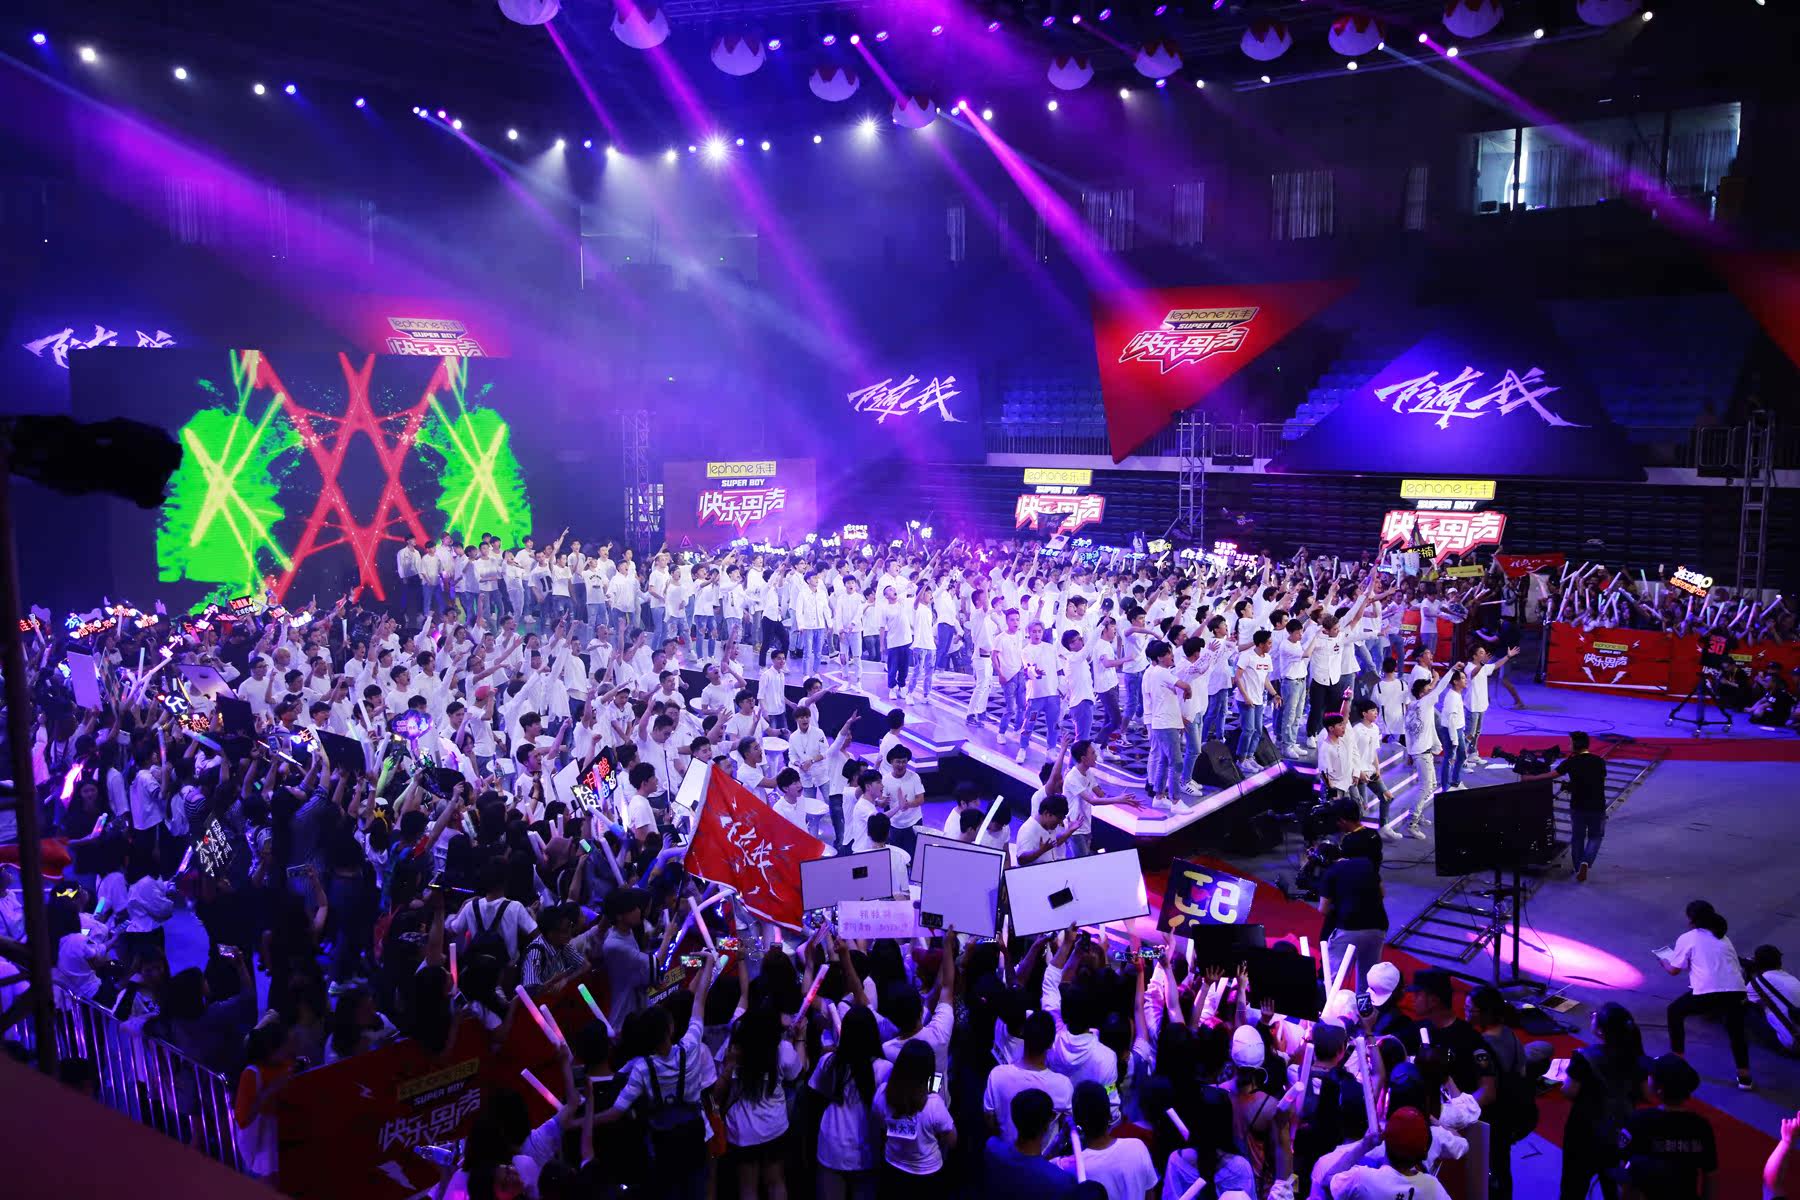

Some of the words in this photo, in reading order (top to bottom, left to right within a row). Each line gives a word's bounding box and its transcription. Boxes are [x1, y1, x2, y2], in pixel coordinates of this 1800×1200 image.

[1170, 309, 1225, 323] lephone
[1177, 322, 1210, 330] SUPER
[1211, 321, 1234, 329] BOY
[411, 331, 440, 339] SUPER
[1129, 330, 1243, 362] 快乐男声
[709, 461, 754, 476] lephone
[721, 479, 748, 487] SUPER
[749, 478, 765, 486] BOY
[1404, 480, 1462, 495] lephone
[699, 487, 785, 528] 快乐男声
[1416, 499, 1453, 510] SUPER
